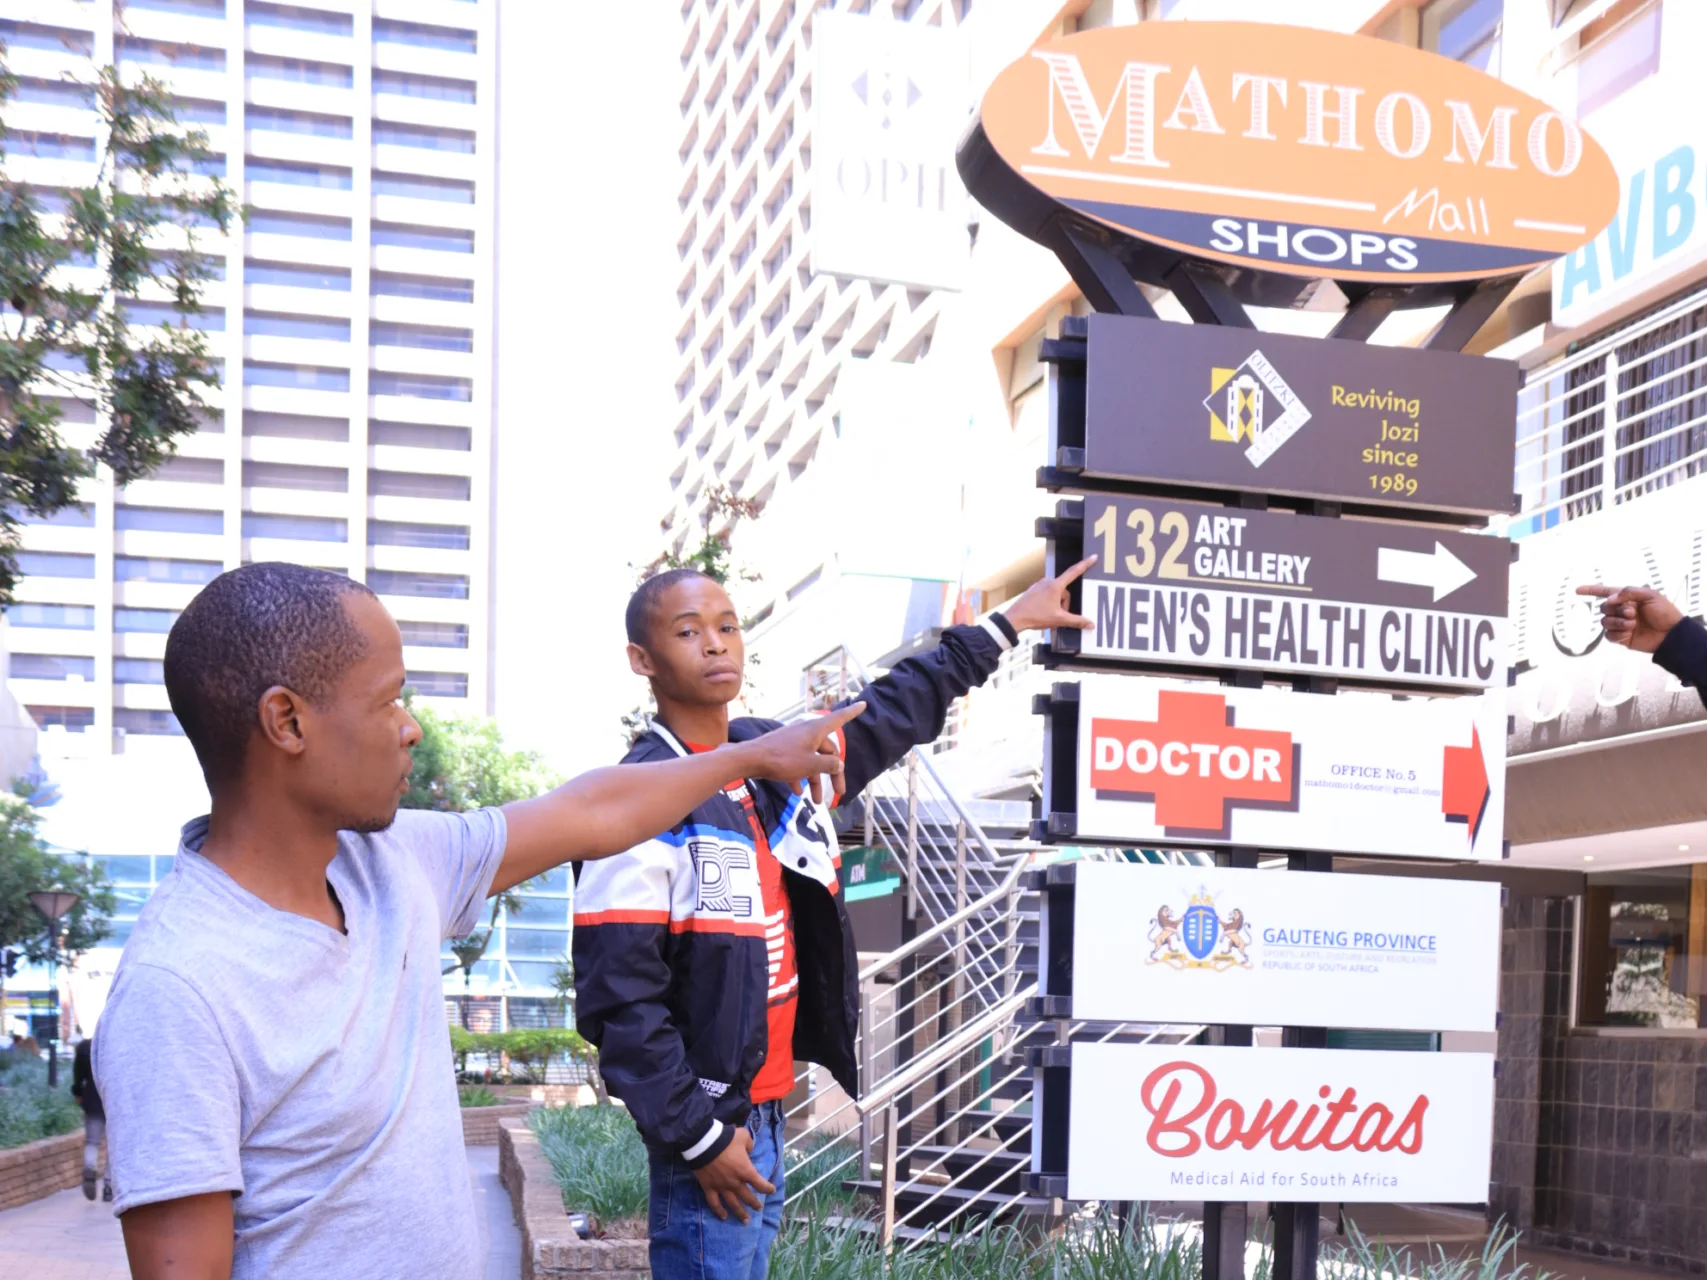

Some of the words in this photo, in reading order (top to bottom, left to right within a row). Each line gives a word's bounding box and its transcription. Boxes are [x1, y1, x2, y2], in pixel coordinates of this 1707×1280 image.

[1031, 49, 1583, 177] MATHOMO
[1382, 187, 1490, 236] Mall
[1209, 218, 1419, 272] SHOPS
[1331, 384, 1420, 419] Reviving
[1380, 419, 1419, 443] Jozi
[1361, 442, 1419, 468] since
[1368, 472, 1418, 497] 1989
[1094, 505, 1190, 578] 132
[1194, 514, 1247, 546] ART
[1194, 546, 1311, 585] GALLERY
[1096, 585, 1211, 656] MEN'S
[1224, 596, 1366, 669] HEALTH
[1379, 610, 1495, 681] CLINIC
[1094, 736, 1283, 782] DOCTOR
[1330, 764, 1381, 779] OFFICE
[1263, 928, 1348, 946] GAUTENG
[1353, 932, 1437, 951] PROVINCE
[1140, 1060, 1430, 1157] Bonitas
[1170, 1171, 1234, 1186] Medical
[1240, 1171, 1265, 1186] Aid
[1271, 1171, 1295, 1187] for
[1300, 1172, 1346, 1187] South
[1351, 1172, 1399, 1187] Africa
